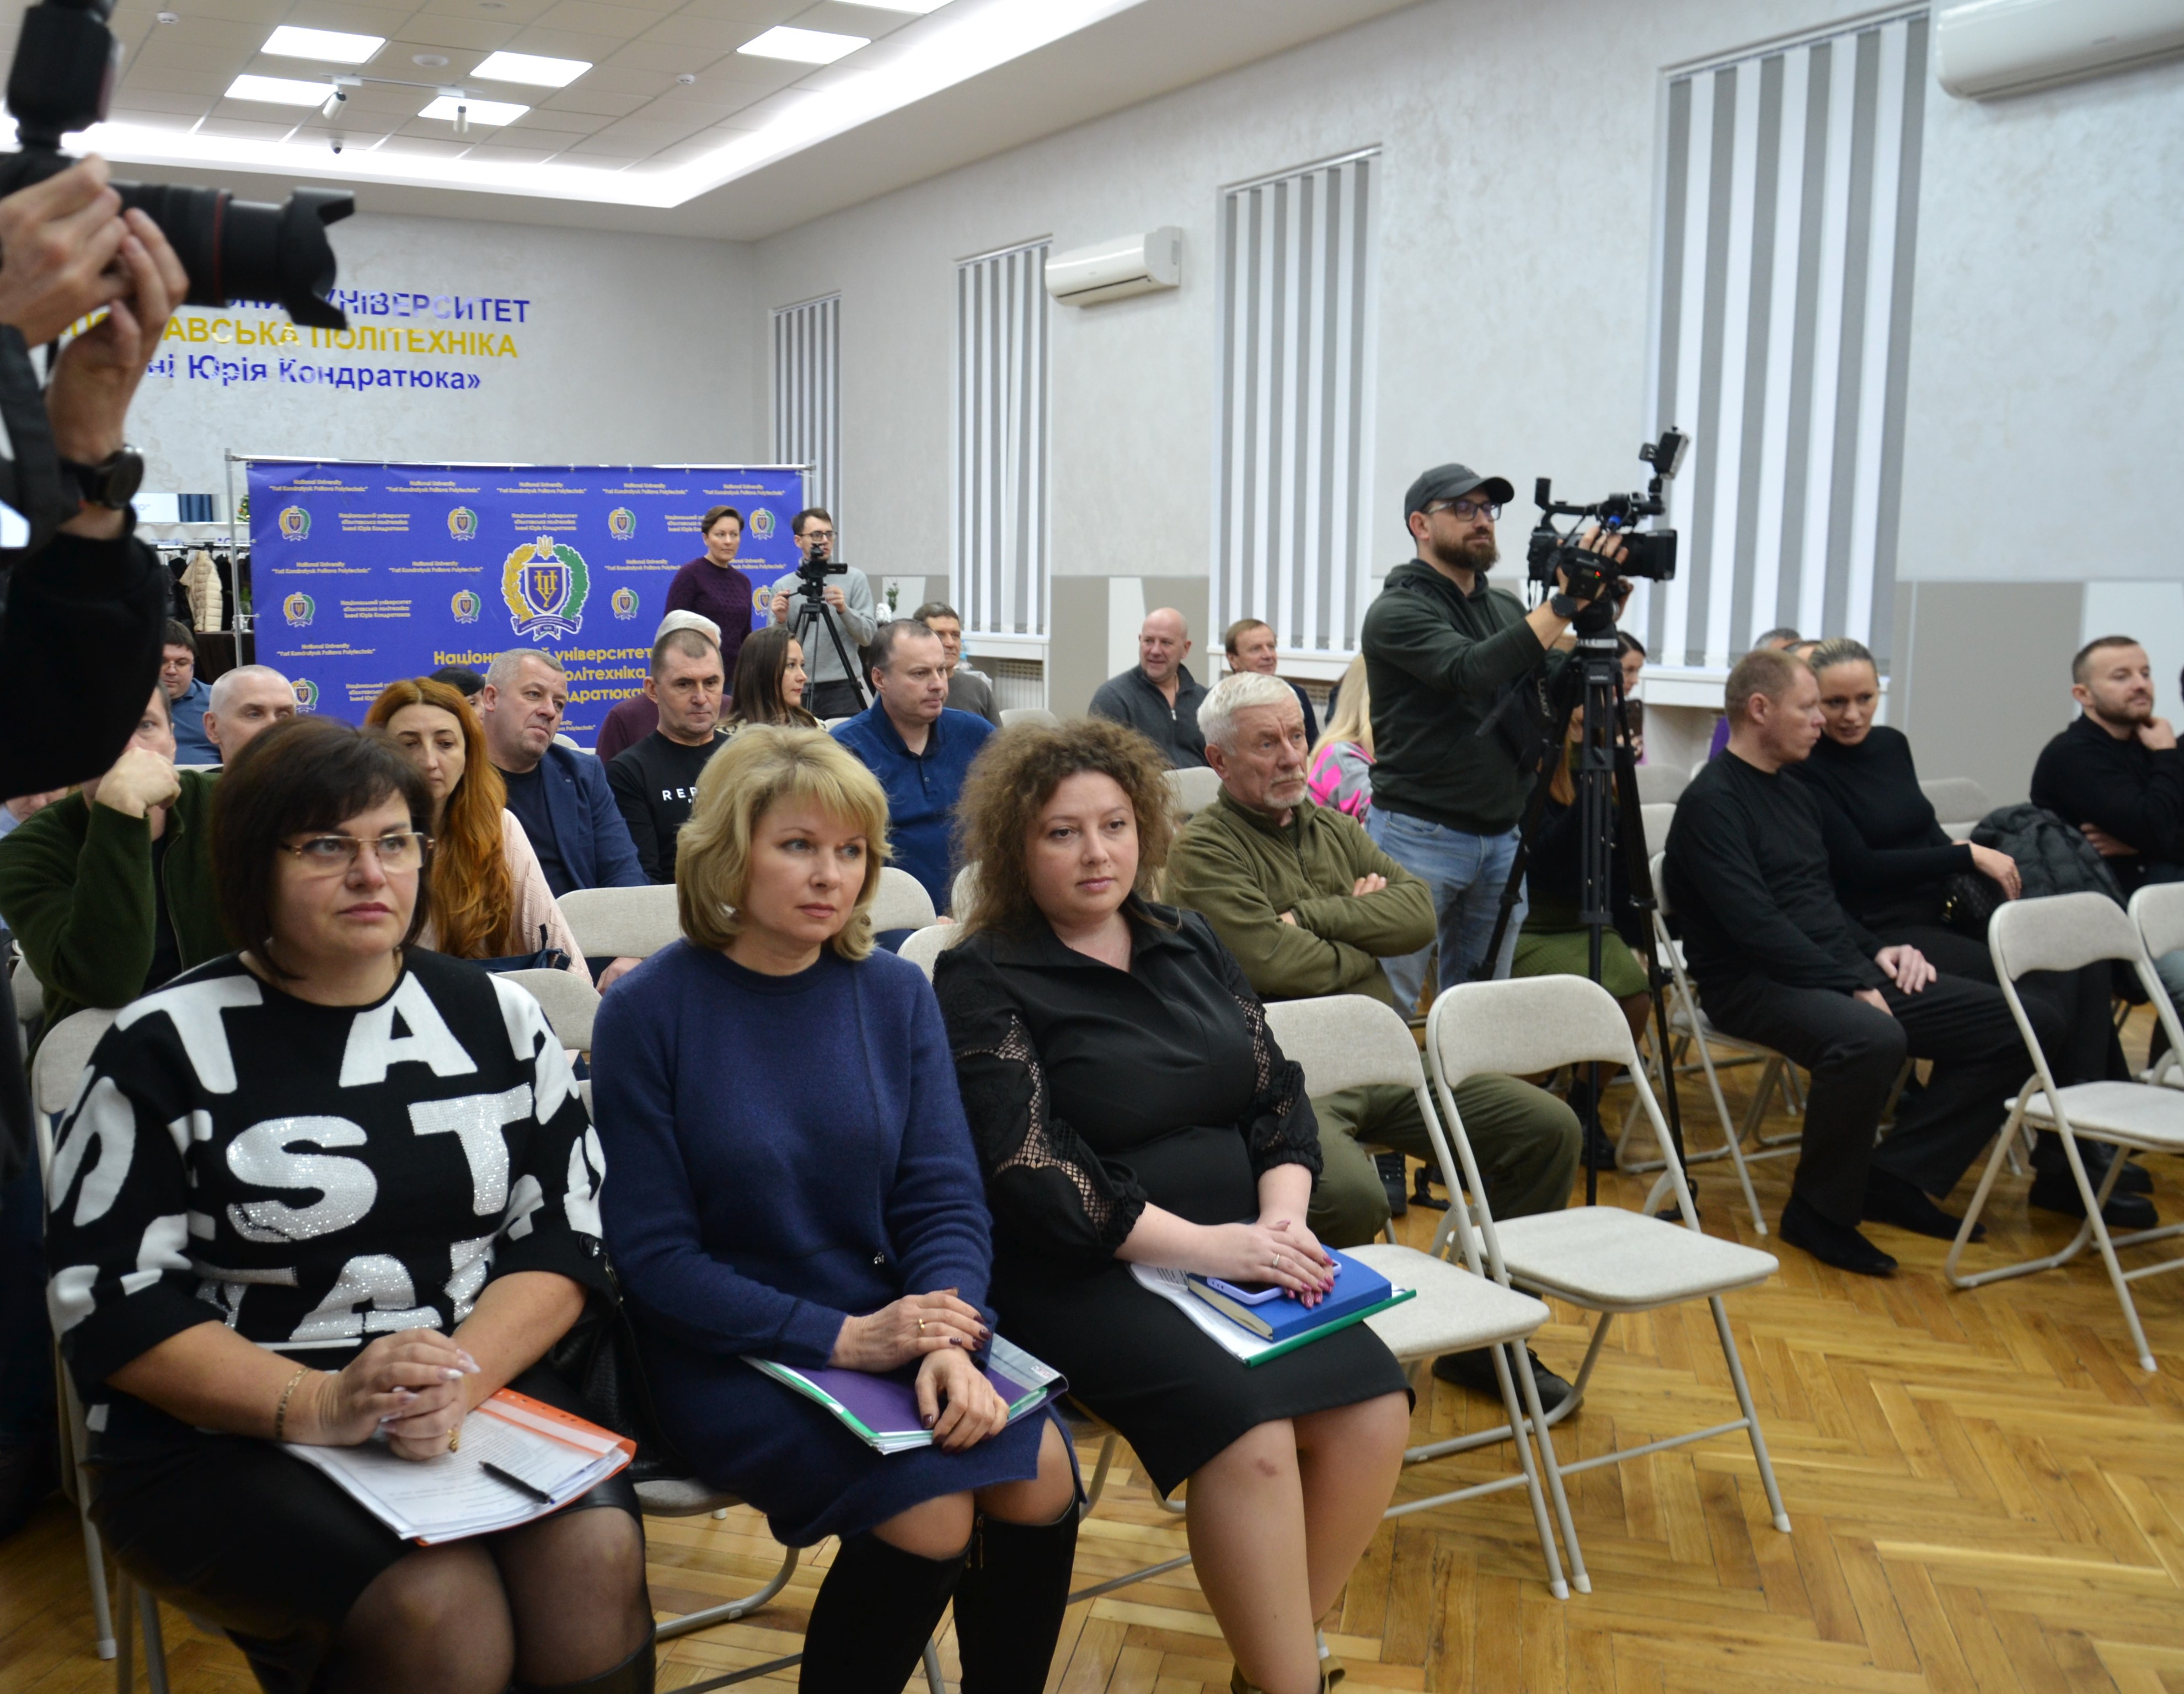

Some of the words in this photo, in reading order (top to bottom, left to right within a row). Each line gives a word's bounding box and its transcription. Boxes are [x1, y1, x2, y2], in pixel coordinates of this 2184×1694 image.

[311, 326, 518, 358] ПОЛІТЕХНІКА
[188, 355, 267, 386] Юрія
[279, 358, 480, 391] Кондратюка»
[554, 646, 653, 663] університет
[565, 665, 646, 682] олітехніка
